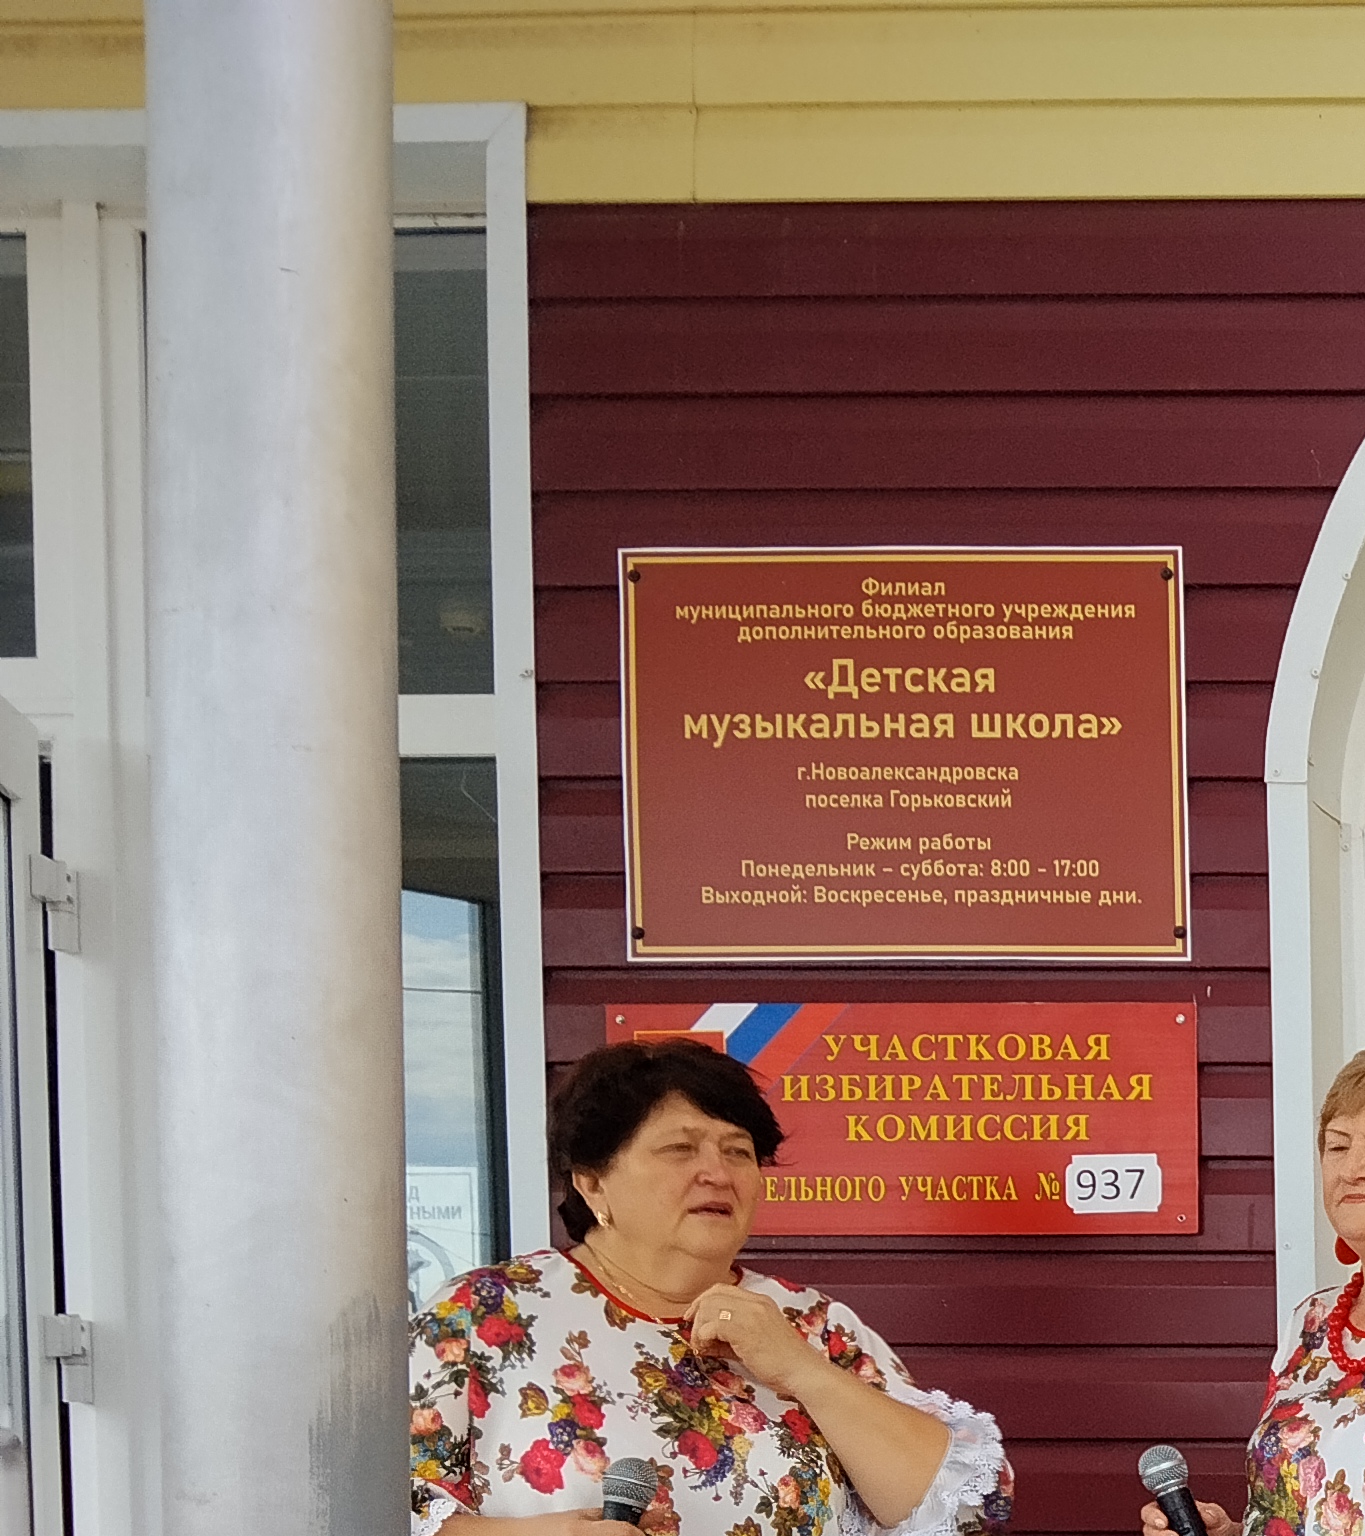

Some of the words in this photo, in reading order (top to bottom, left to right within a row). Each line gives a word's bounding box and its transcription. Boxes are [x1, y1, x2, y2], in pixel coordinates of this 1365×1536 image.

[861, 577, 946, 597] Филиал
[675, 603, 855, 623] муниципального
[861, 599, 996, 622] бюджетного
[1001, 602, 1136, 622] учреждения
[737, 623, 926, 642] дополнительного
[932, 622, 1074, 643] образования
[803, 657, 996, 699] «Детская
[683, 712, 955, 748] музыкальная
[970, 711, 1123, 739] школа»
[797, 761, 1019, 786] г.Новоалександровска
[805, 792, 884, 809] поселка
[889, 788, 1012, 813] Горьковский
[846, 832, 912, 851] Режим
[918, 832, 992, 855] работы
[741, 859, 876, 880] Понедельник
[899, 858, 984, 882] суббота:
[990, 858, 1031, 878] 8:00
[1052, 859, 1100, 878] 17:00
[701, 884, 808, 907] Выходной:
[813, 885, 948, 908] Воскресенье,
[954, 889, 1092, 908] праздничные
[1097, 890, 1143, 907] дни.
[821, 1033, 1111, 1062] УЧАСТКОВАЯ
[780, 1073, 1154, 1102] ИЗБИРАТЕЛЬНАЯ
[845, 1113, 1090, 1142] КОМИССИЯ
[760, 1175, 886, 1202] ЕЛЬНОГО
[898, 1175, 1019, 1201] УЧАСТКА
[1034, 1172, 1060, 1201] №
[1076, 1169, 1145, 1200] 937
[408, 1205, 463, 1221] НЫМИ
